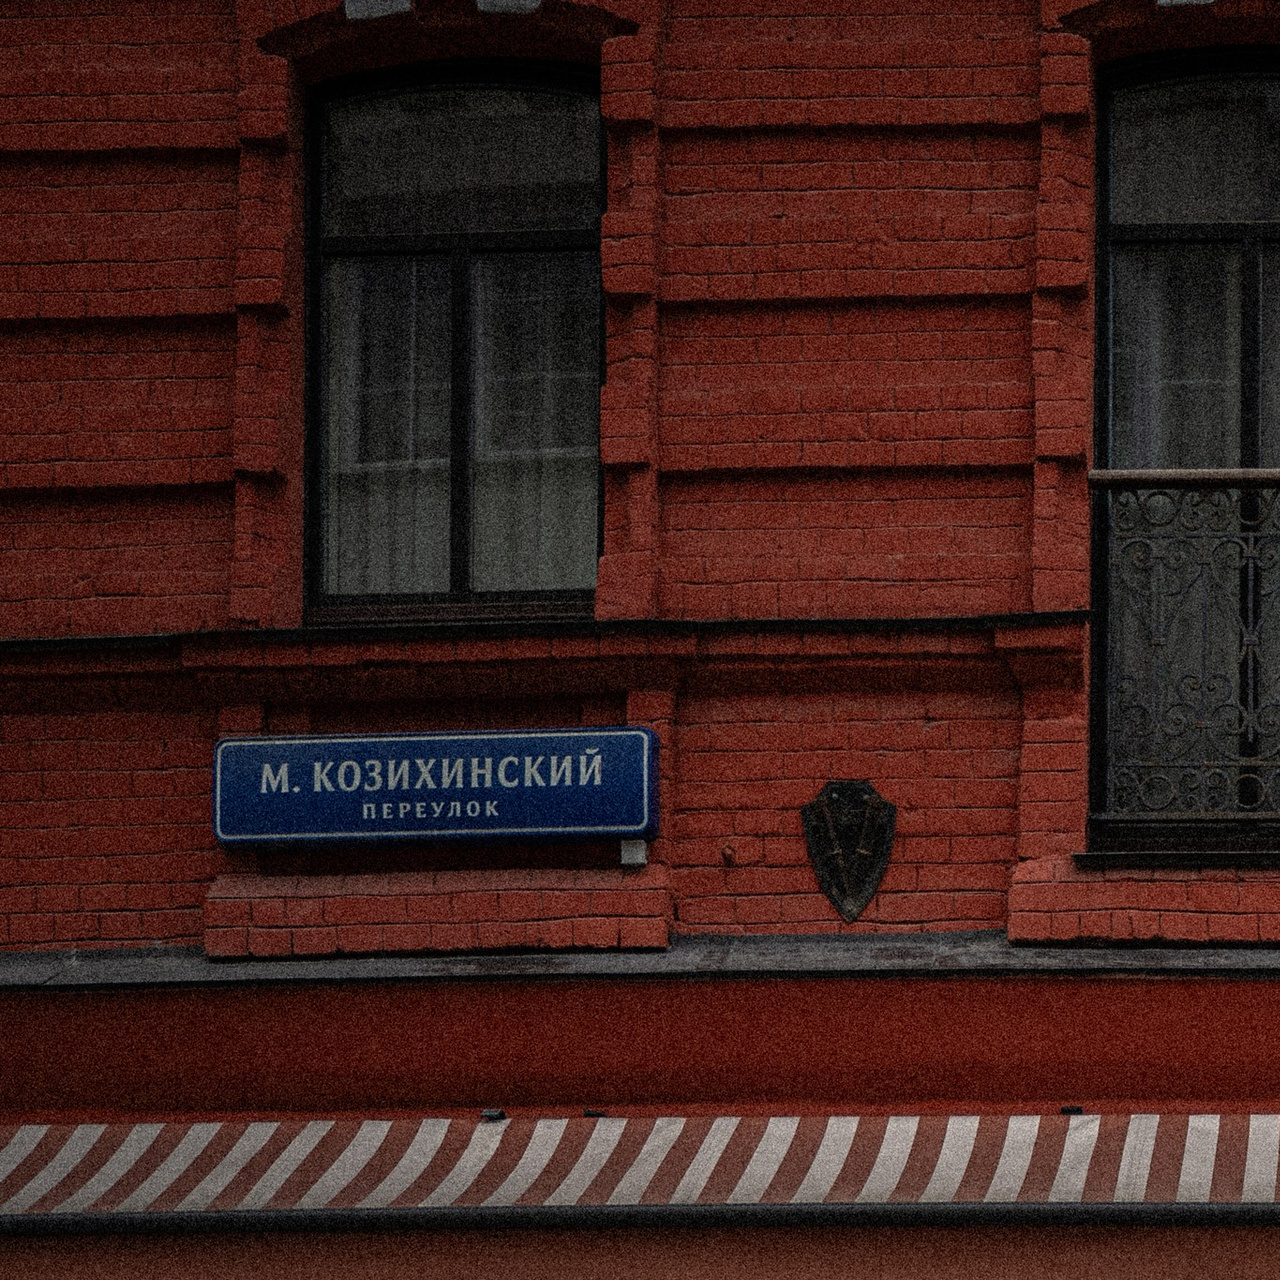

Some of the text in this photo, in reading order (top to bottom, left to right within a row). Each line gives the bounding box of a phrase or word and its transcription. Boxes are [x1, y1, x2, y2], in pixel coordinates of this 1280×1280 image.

[262, 749, 601, 793] М. КОЗИХИНСКИЙ
[364, 802, 497, 818] ПЕРЕУЛОК
